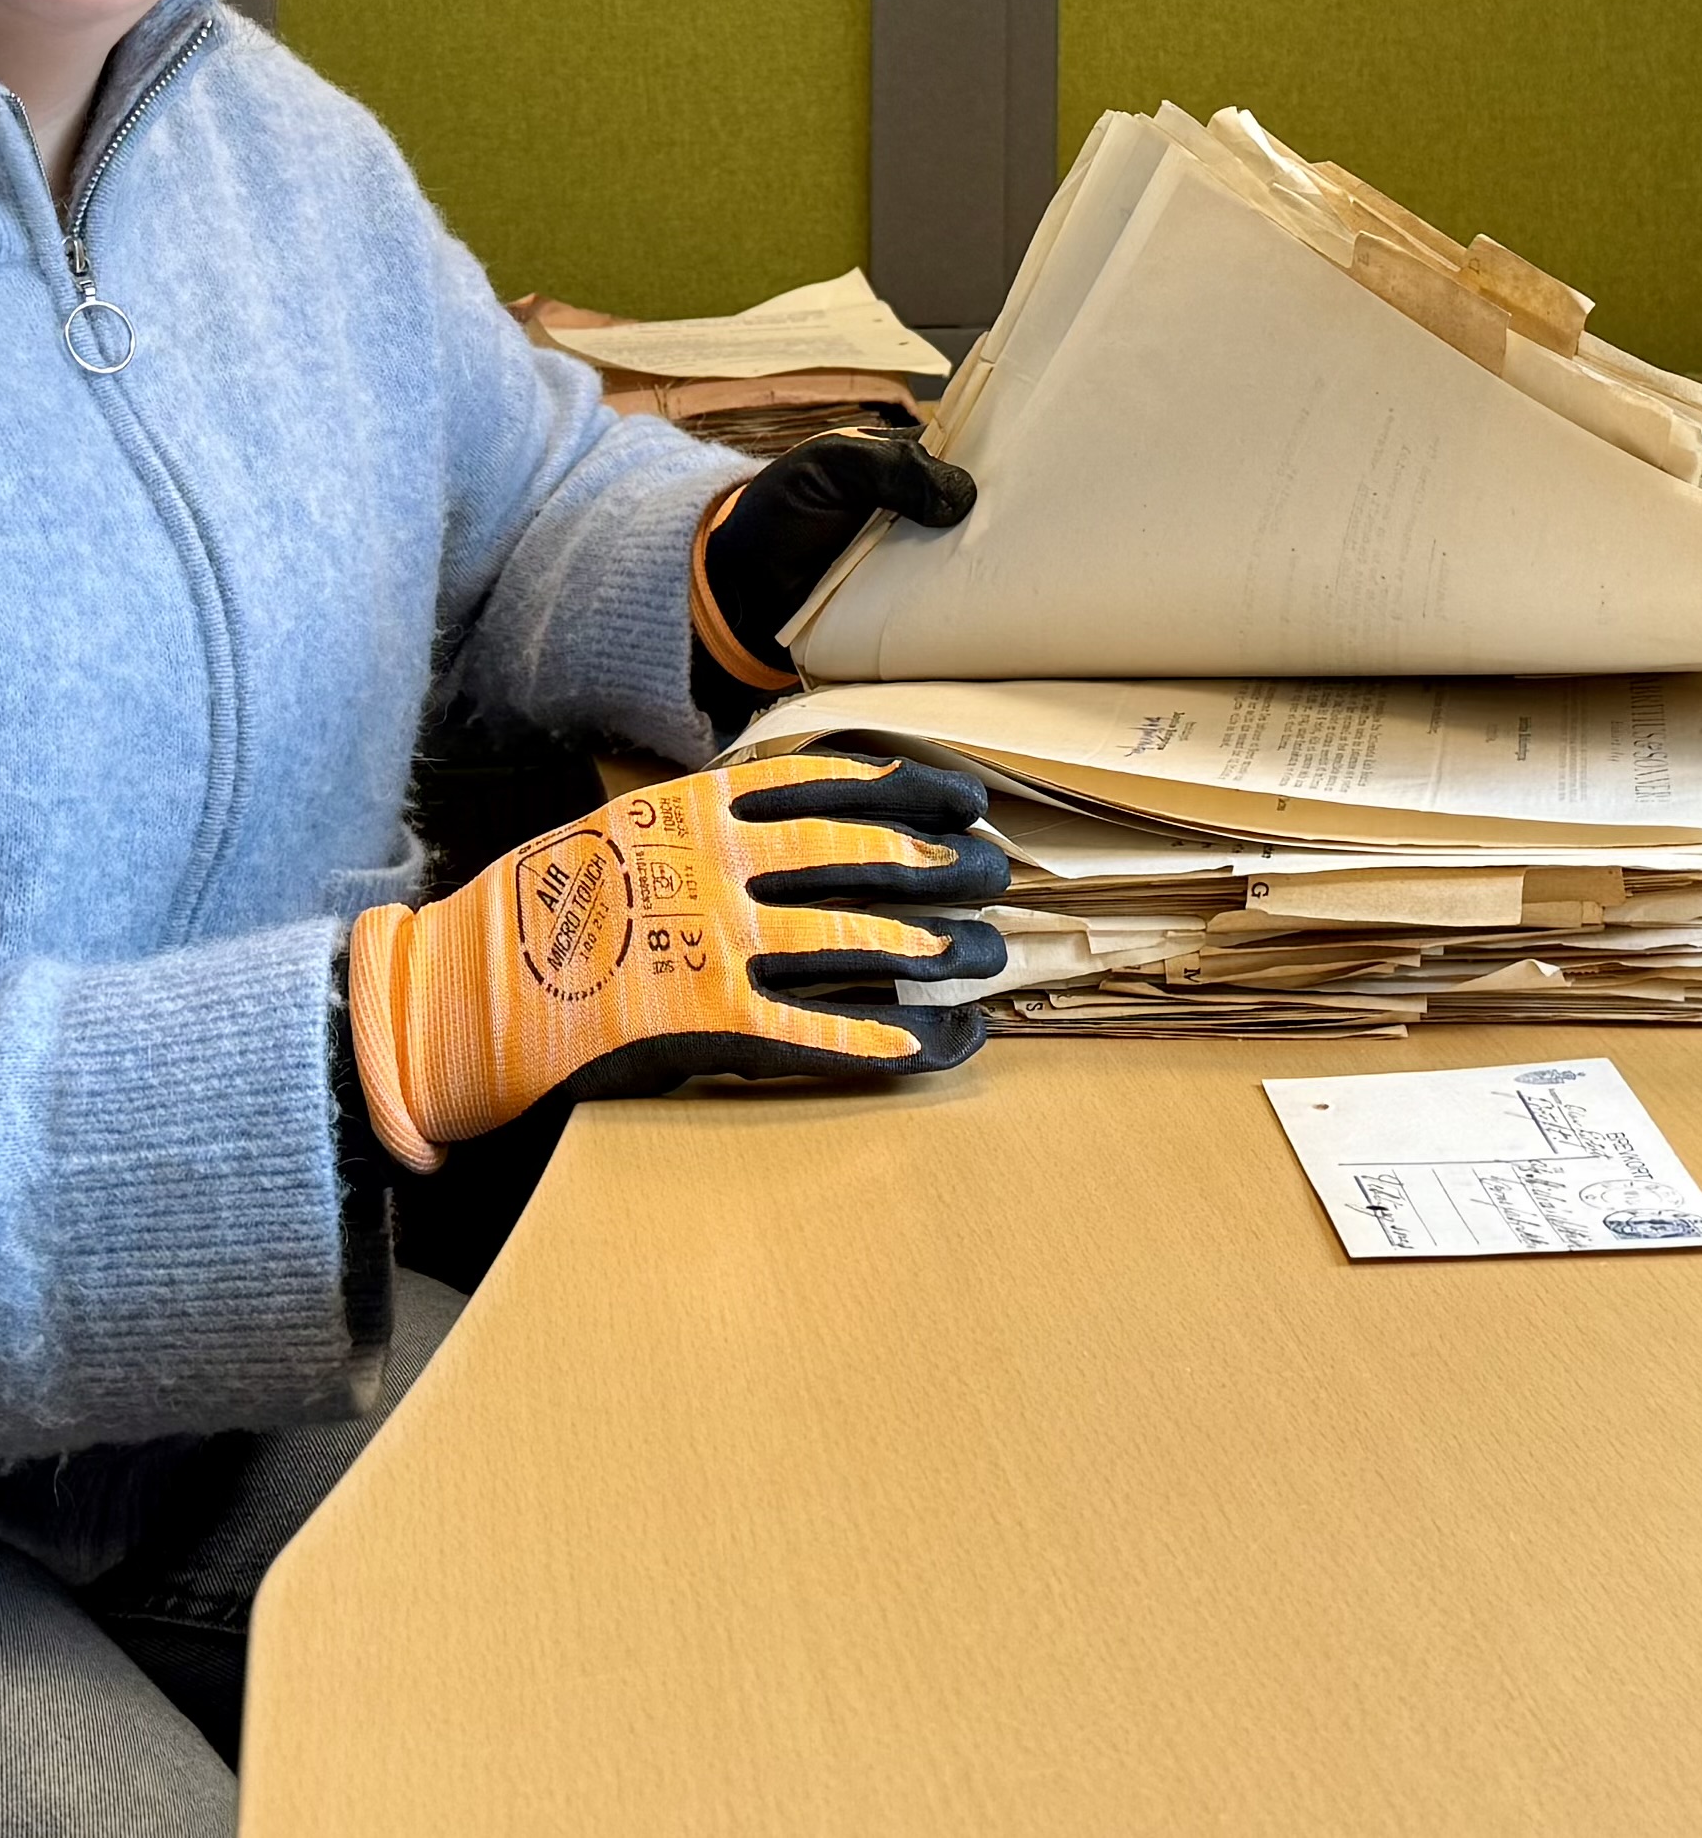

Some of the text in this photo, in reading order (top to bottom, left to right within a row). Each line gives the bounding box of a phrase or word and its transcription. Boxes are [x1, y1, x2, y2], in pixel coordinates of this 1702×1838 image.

[536, 862, 570, 914] AIR
[1251, 881, 1269, 899] G
[547, 910, 581, 971] MICRO
[572, 853, 607, 911] TOUCH
[648, 929, 671, 952] 8
[1025, 1002, 1044, 1012] S
[1607, 1131, 1653, 1179] BREVKORT
